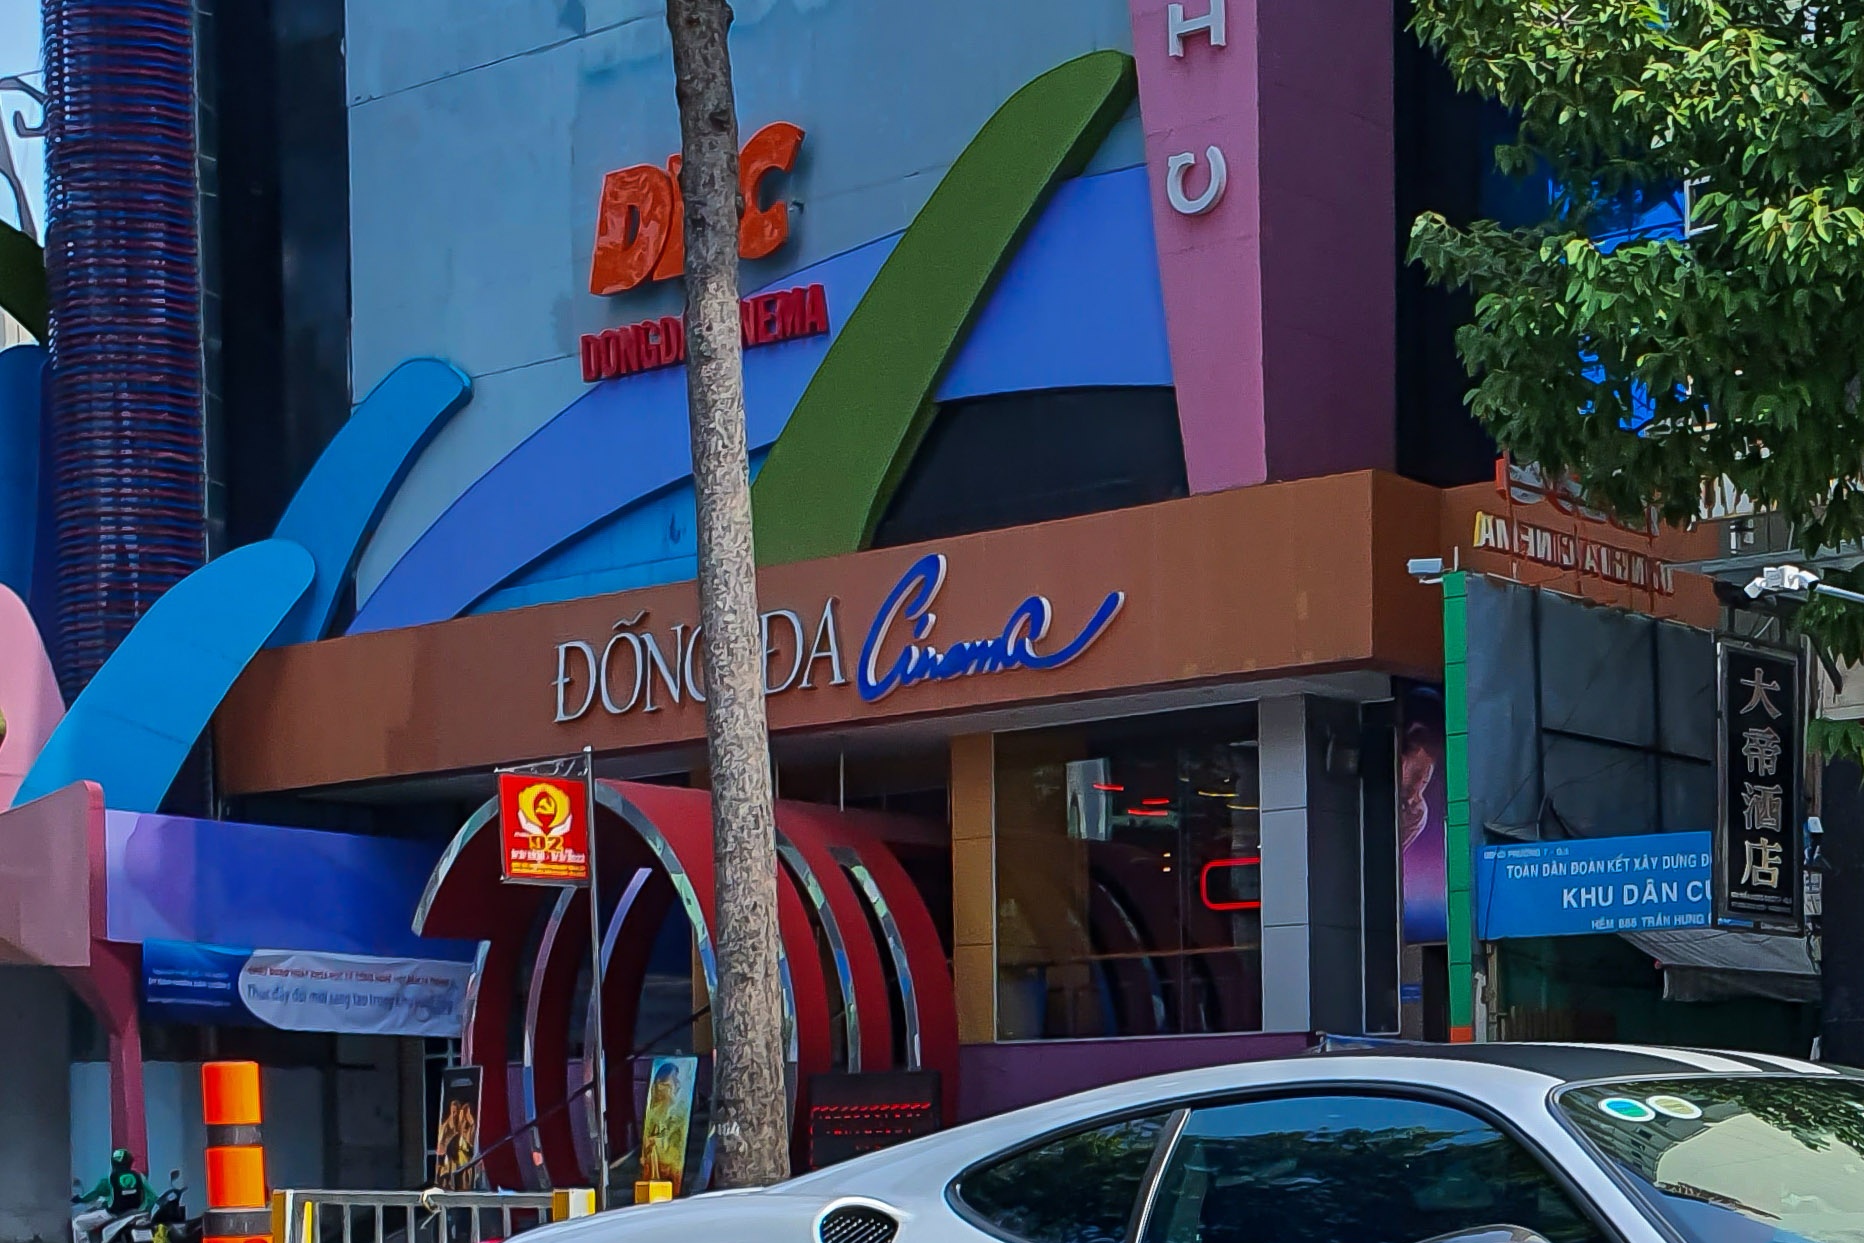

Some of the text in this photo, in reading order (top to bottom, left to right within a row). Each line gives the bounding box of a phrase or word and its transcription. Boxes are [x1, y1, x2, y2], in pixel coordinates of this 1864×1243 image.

[590, 121, 806, 296] DC
[579, 282, 829, 383] DONGD NEMA
[759, 596, 850, 696] ĐA
[1542, 859, 1567, 877] DÂN
[1607, 852, 1630, 874] KẾT
[1633, 853, 1658, 872] XÂY
[1662, 851, 1697, 874] DỰNG
[1562, 885, 1614, 910] KHU
[1622, 878, 1678, 906] DÂN
